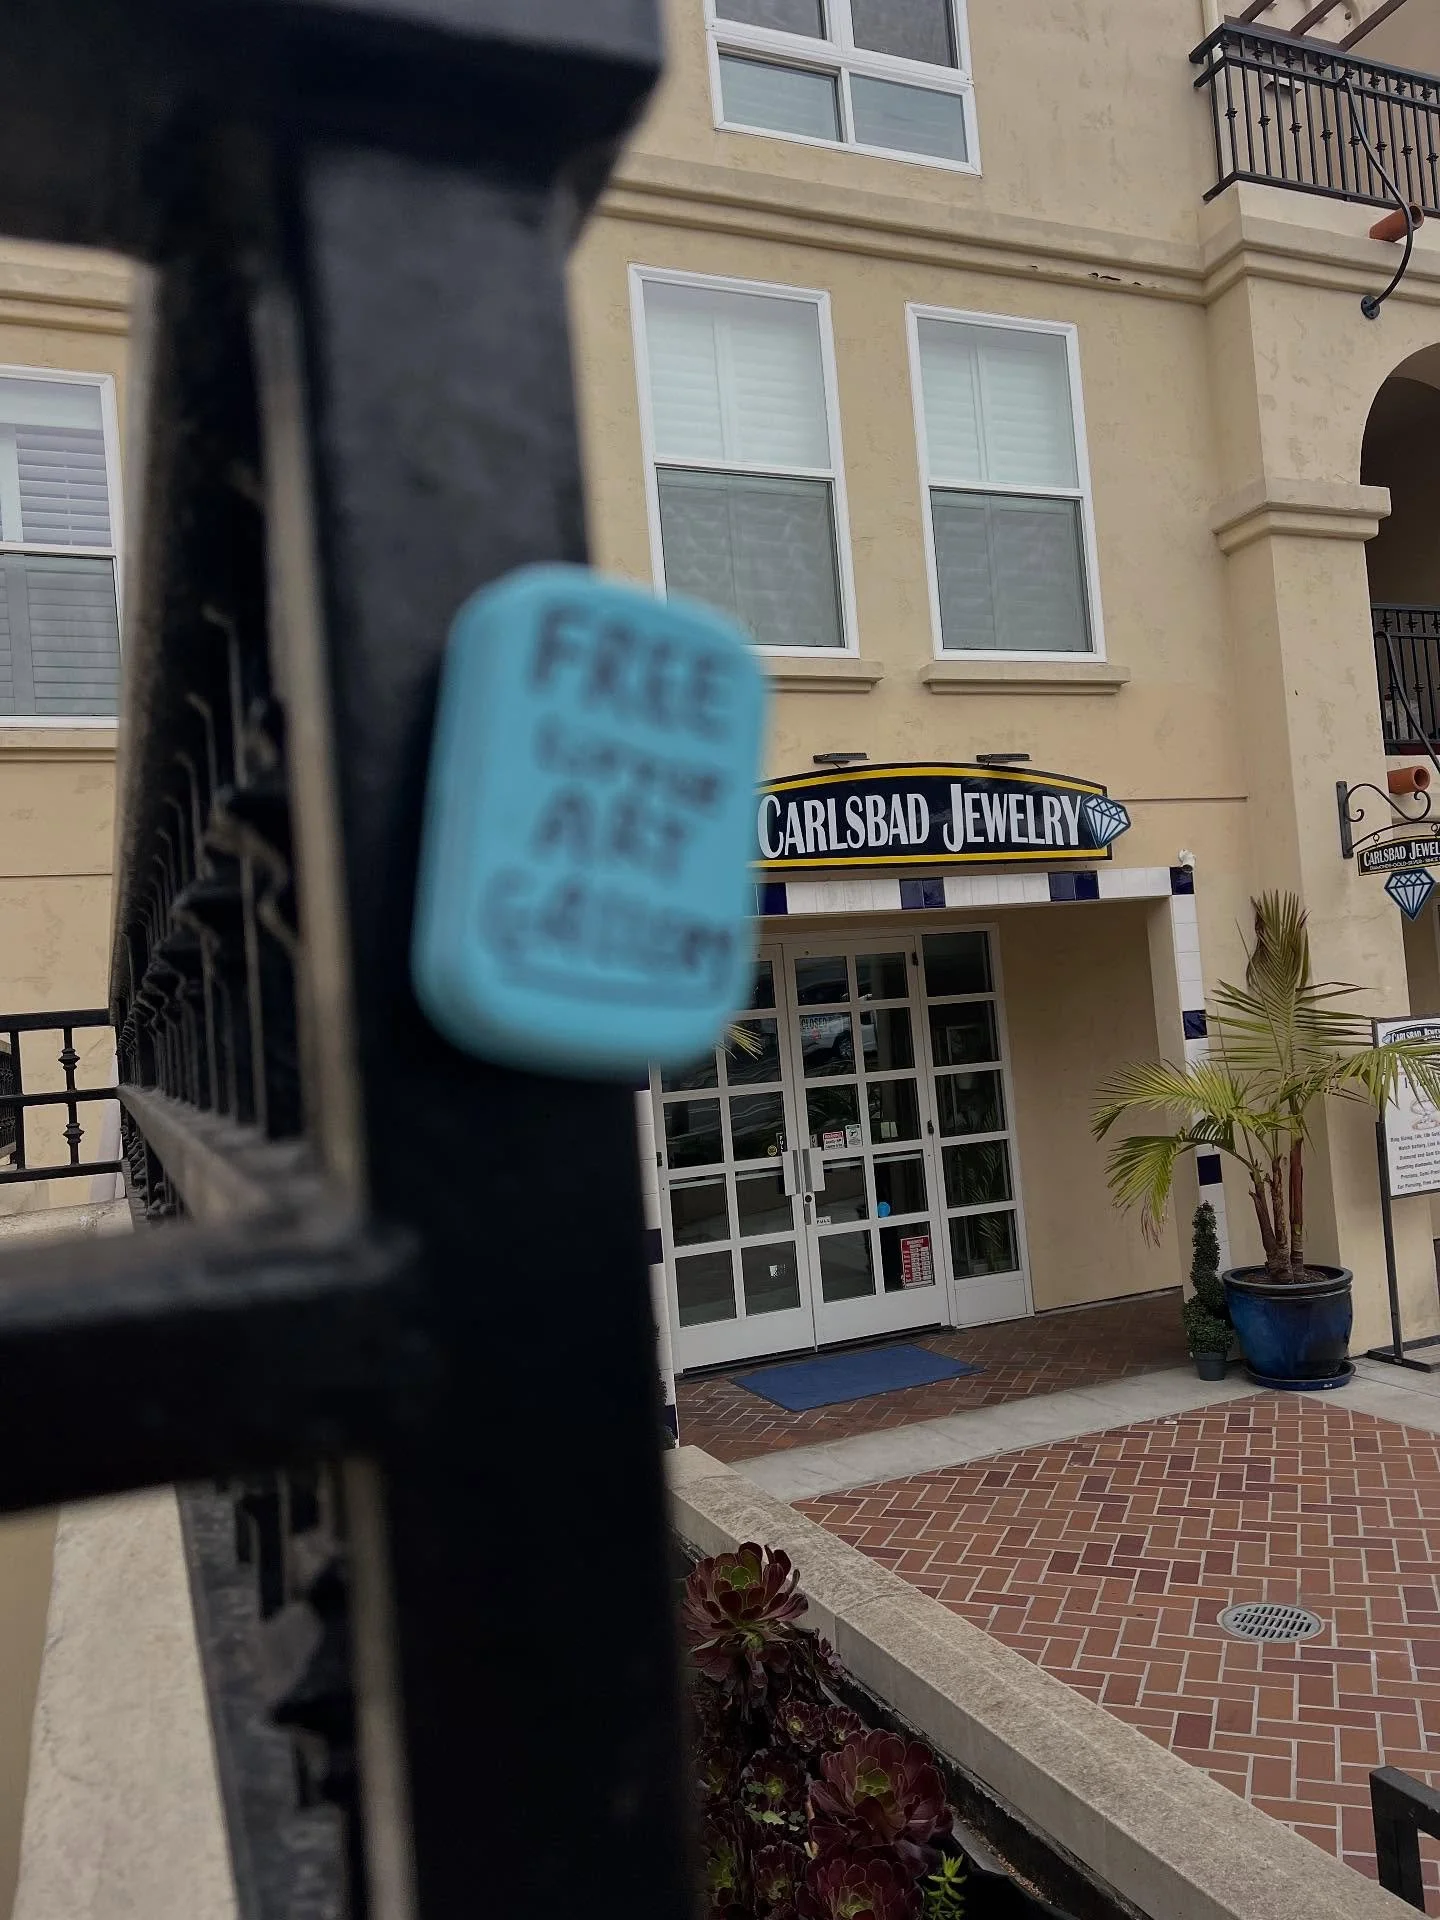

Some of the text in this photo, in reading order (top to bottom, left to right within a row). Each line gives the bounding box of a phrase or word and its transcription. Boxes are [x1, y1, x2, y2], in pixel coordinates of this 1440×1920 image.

[529, 603, 733, 742] FREE
[757, 784, 1082, 859] CARLSBAD JEWELRY
[1363, 846, 1406, 867] CARLSBAD
